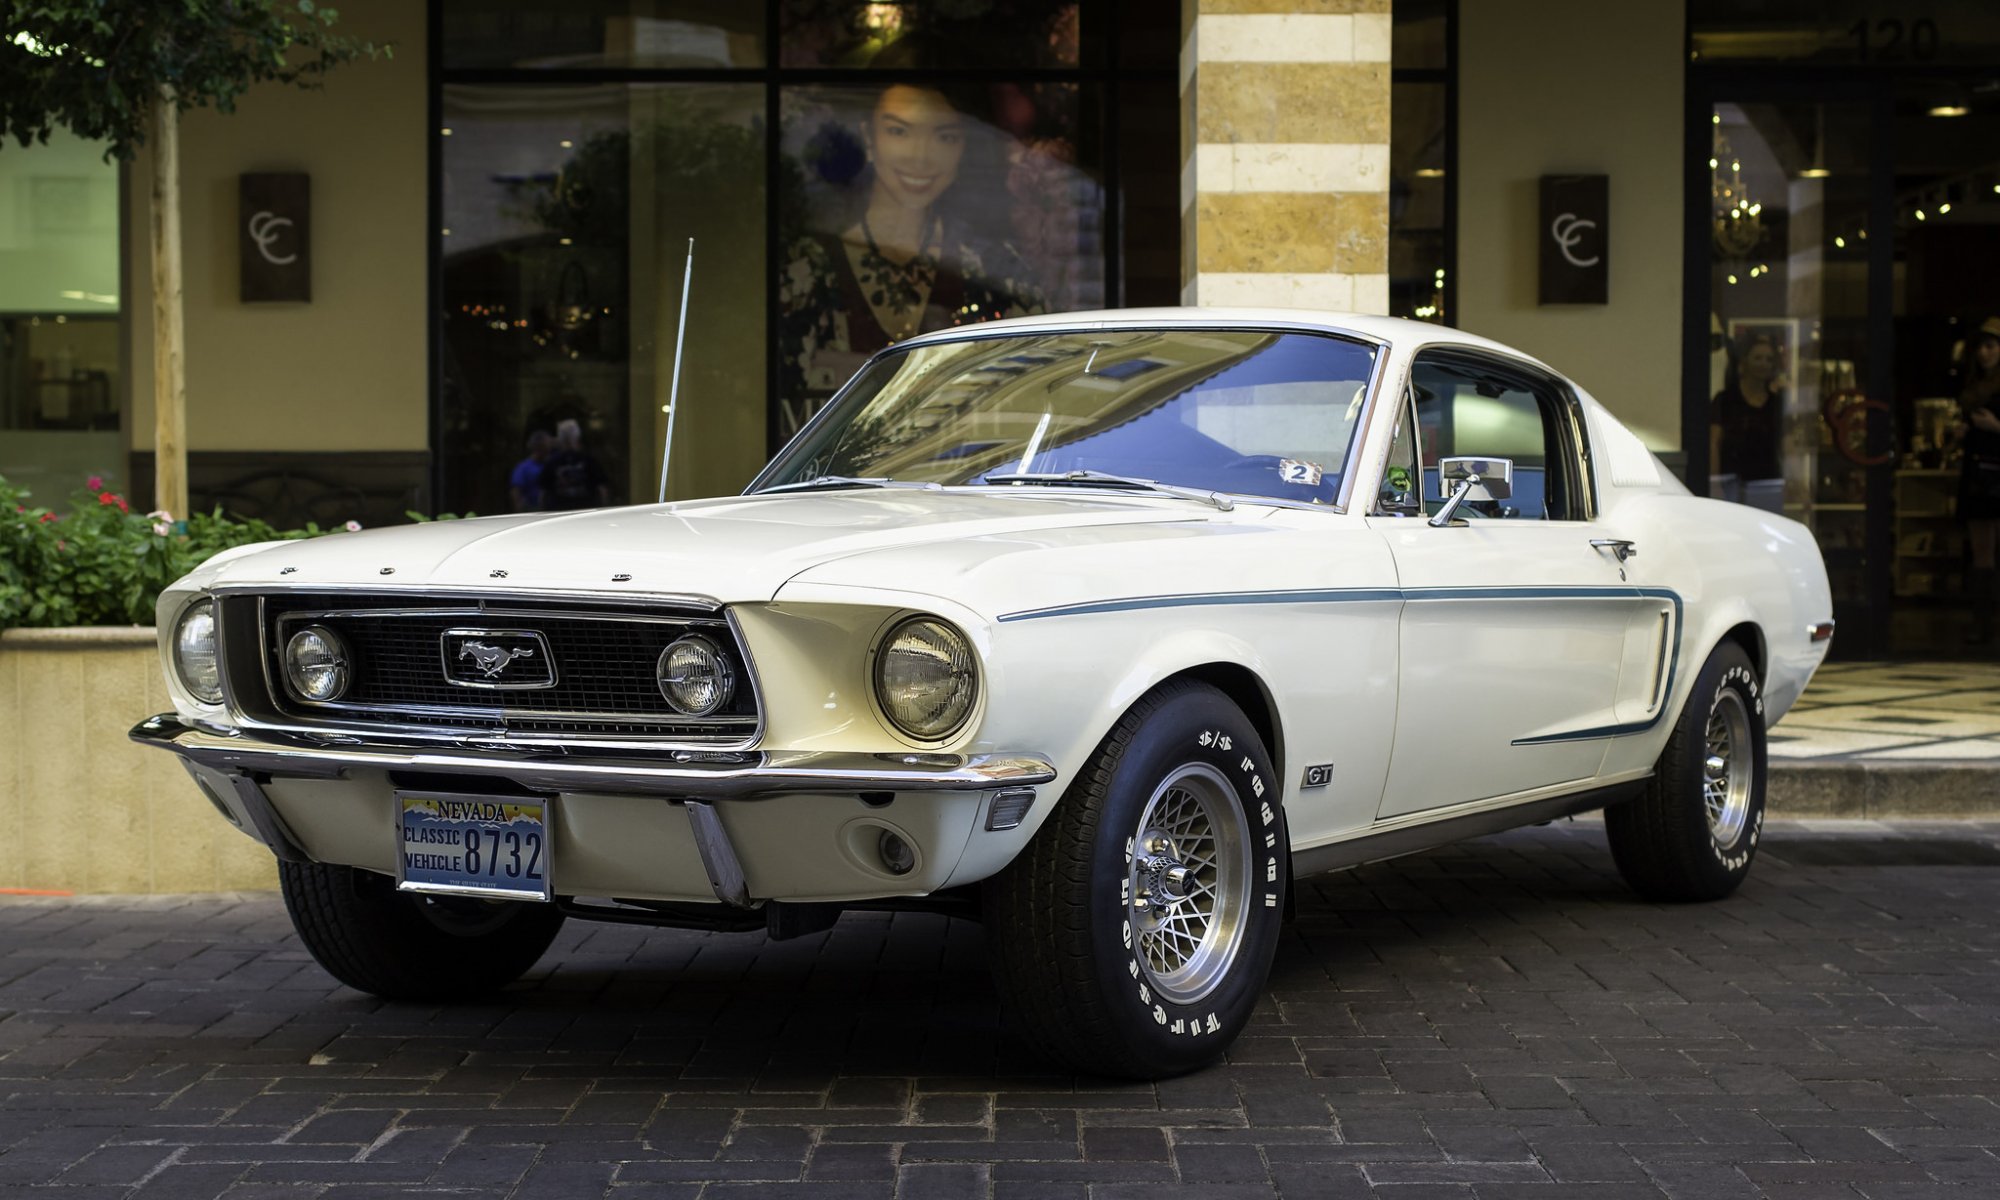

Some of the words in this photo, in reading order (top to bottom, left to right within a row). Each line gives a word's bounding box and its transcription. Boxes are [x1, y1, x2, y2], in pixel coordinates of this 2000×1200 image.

[1848, 18, 1938, 61] 120
[1291, 465, 1307, 479] 2
[1309, 766, 1333, 784] GT
[437, 800, 508, 822] NEVADA
[404, 827, 460, 846] CLASSIC
[405, 852, 462, 872] VEHICLE
[465, 828, 542, 880] 8732
